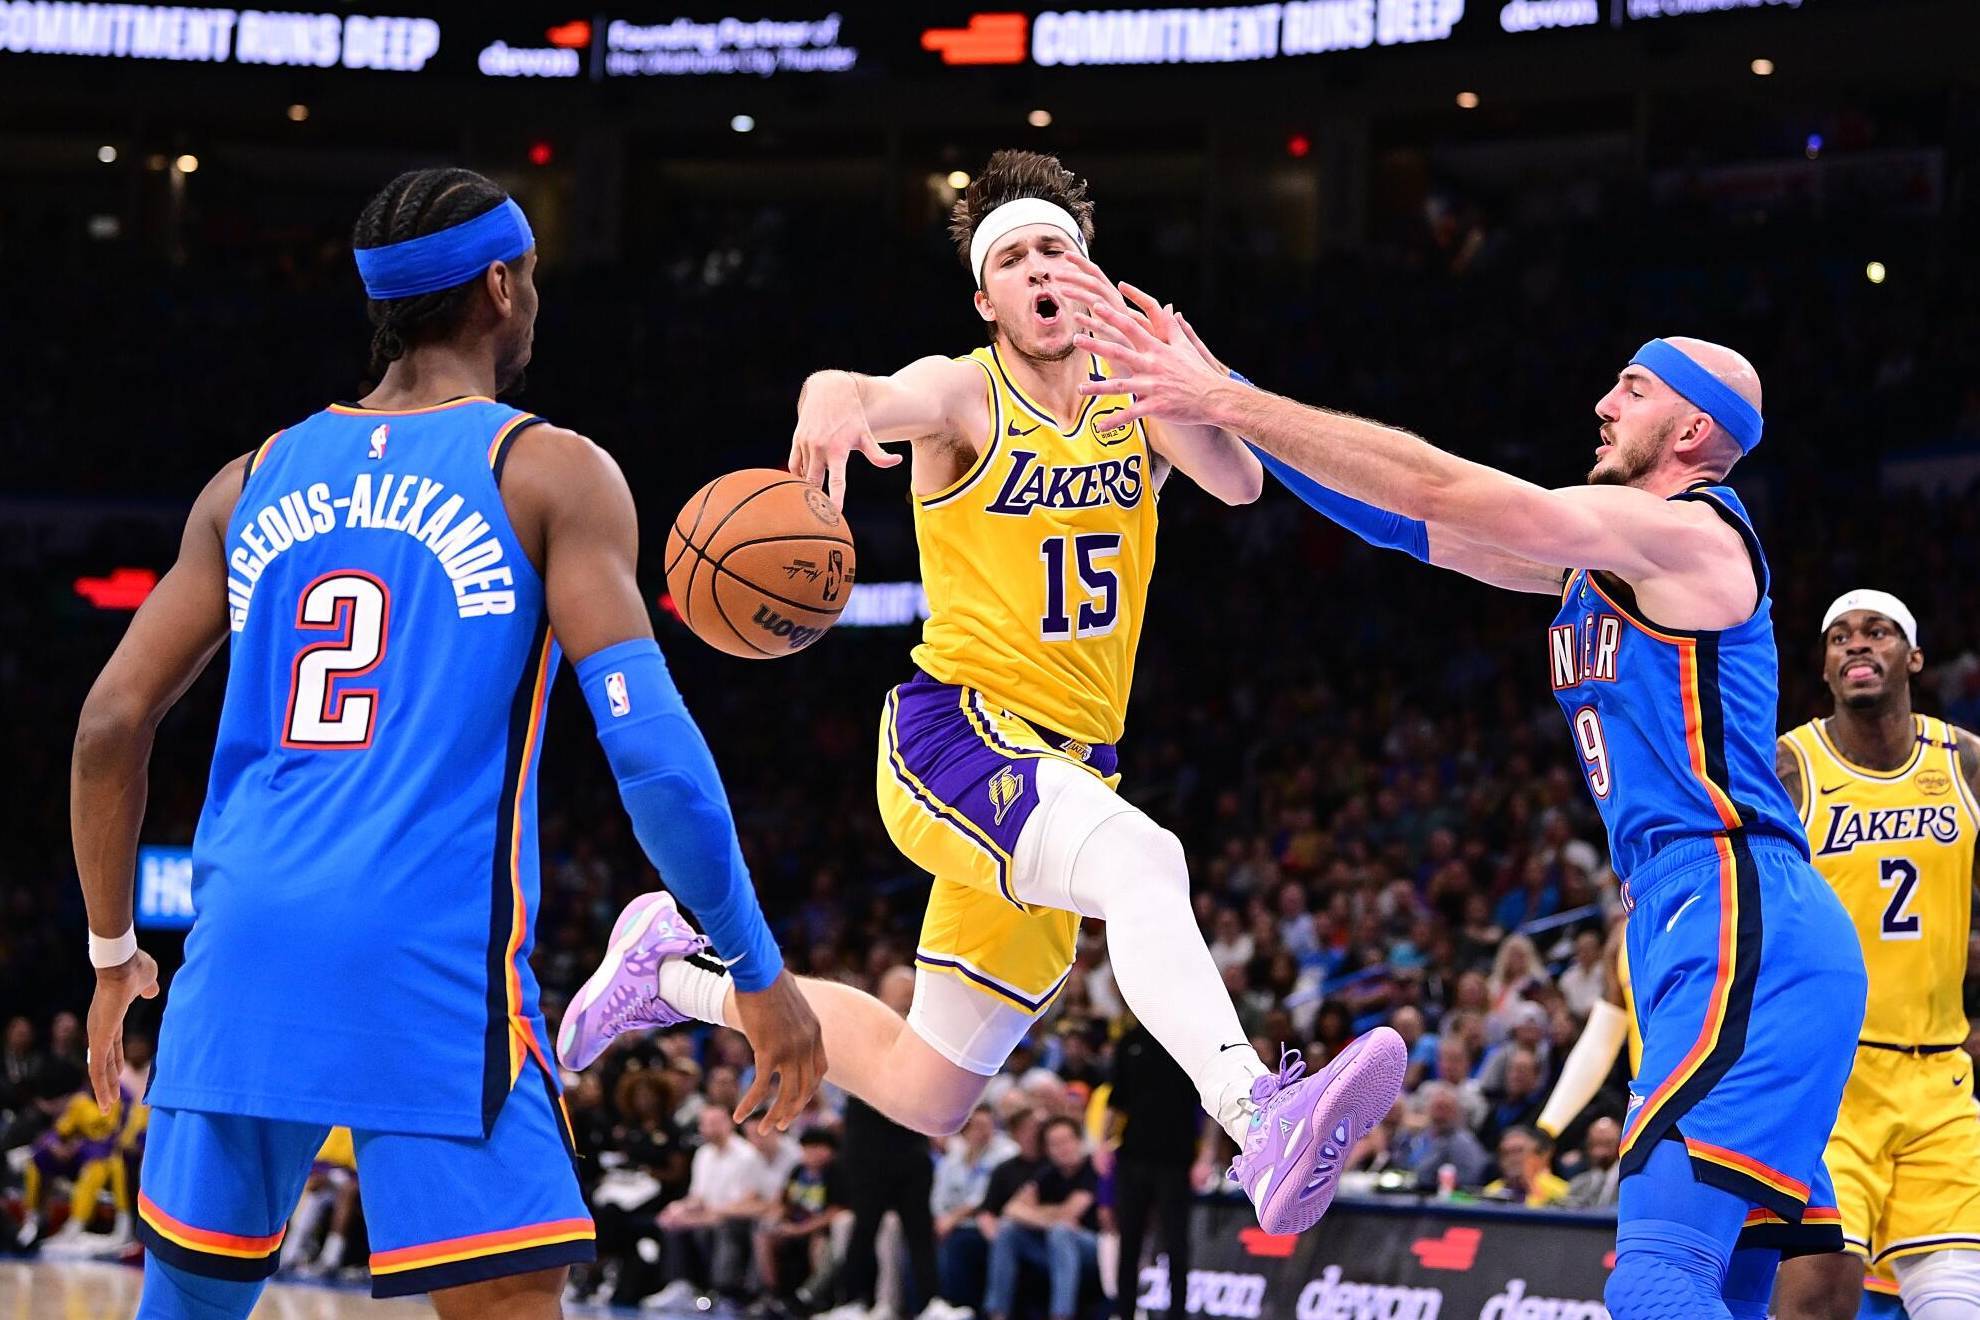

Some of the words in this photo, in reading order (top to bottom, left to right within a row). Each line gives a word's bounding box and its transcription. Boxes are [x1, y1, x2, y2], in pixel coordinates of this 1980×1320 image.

[342, 15, 440, 71] DEEP
[984, 450, 1143, 517] LAKERS
[227, 473, 516, 633] GILGEOUS-ALEXANDER
[1039, 533, 1124, 642] 15
[280, 568, 390, 750] 2
[1060, 738, 1093, 761] LAKERS
[1573, 705, 1612, 801] 9
[1815, 803, 1960, 858] LAKERS
[1879, 857, 1922, 941] 2
[1136, 1253, 1266, 1318] dvon
[1295, 1264, 1443, 1320] devon
